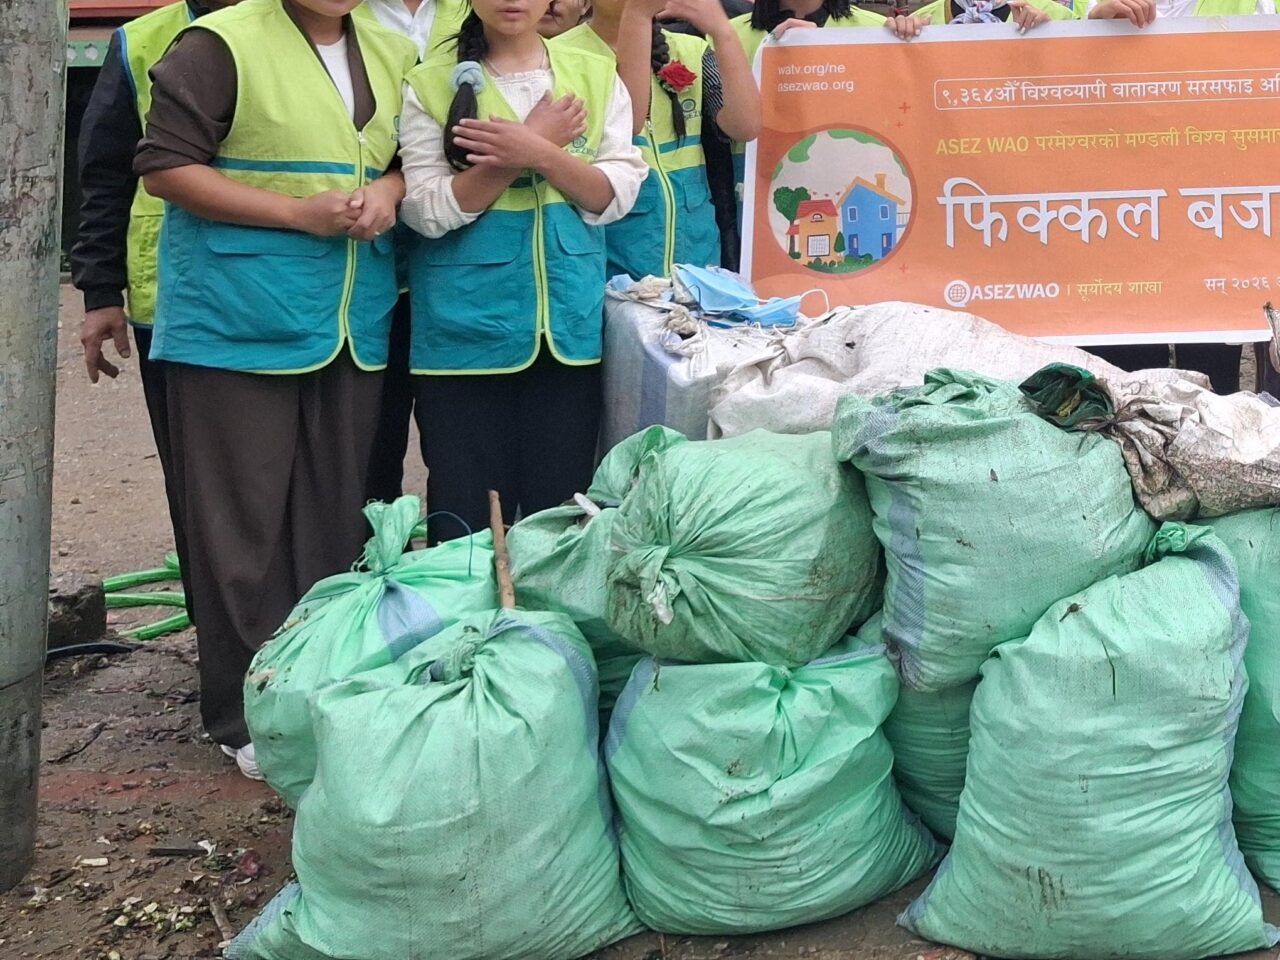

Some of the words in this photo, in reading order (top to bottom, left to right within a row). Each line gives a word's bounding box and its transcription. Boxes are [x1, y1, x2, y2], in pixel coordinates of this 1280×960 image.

[778, 62, 846, 77] watv.org/ne
[777, 79, 854, 93] asezwao.org
[1021, 78, 1107, 102] विश्वव्यापी
[1111, 80, 1180, 99] वातावरण
[1186, 77, 1253, 96] सरसफाइ
[936, 137, 980, 156] ASEZ
[987, 135, 1030, 154] WAO
[1034, 128, 1120, 152] परमेश्वरको
[1125, 125, 1179, 149] मण्डली
[1184, 125, 1227, 147] विश्व
[936, 176, 1168, 248] फिक्कल
[971, 281, 1060, 302] ASEZWAO
[1077, 277, 1123, 302] सूर्योदय
[1129, 279, 1163, 295] शाखा
[1204, 277, 1228, 297] सन्
[1231, 276, 1269, 290] २०२६
